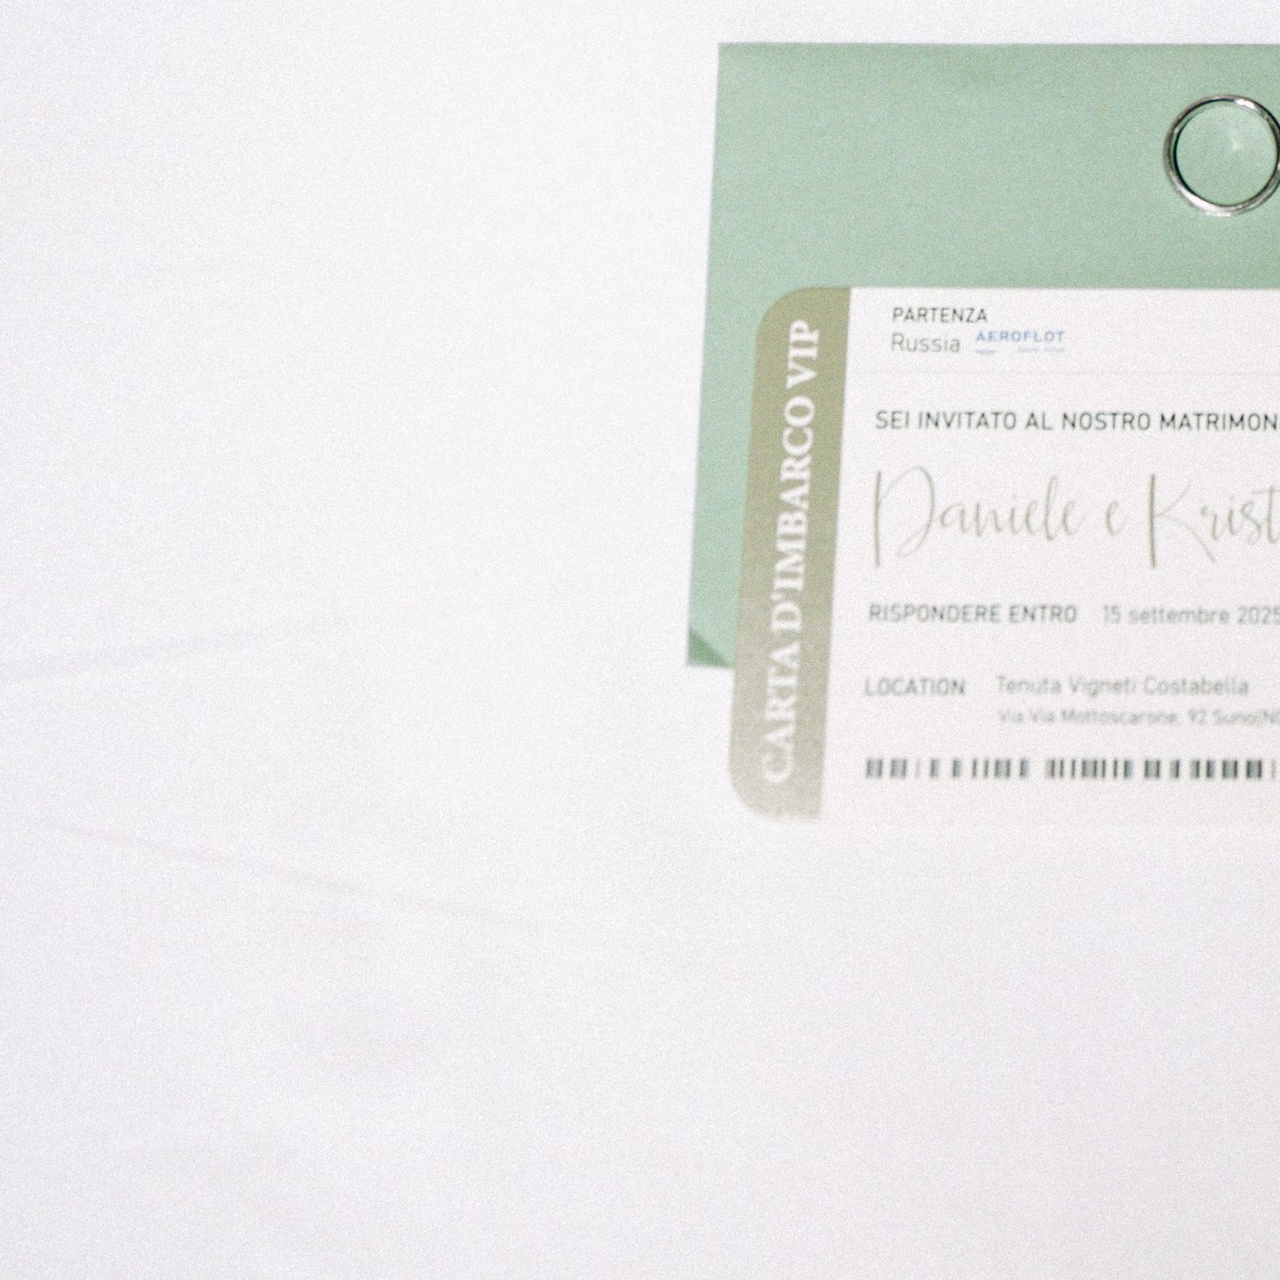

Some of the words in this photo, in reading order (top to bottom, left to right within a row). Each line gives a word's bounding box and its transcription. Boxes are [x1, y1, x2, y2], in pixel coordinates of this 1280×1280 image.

[891, 306, 988, 324] PARTENZA
[890, 332, 961, 354] Russia
[975, 330, 1066, 343] AEROFLOT
[785, 319, 820, 390] VIP
[874, 409, 911, 432] SEI
[917, 410, 1018, 432] INVITATO
[1024, 411, 1054, 432] AL
[1061, 410, 1152, 433] NOSTRO
[769, 395, 816, 632] D'IMBARCO
[873, 465, 1086, 569] Daniele
[1105, 498, 1129, 538] e
[868, 602, 1001, 625] RISPONDERE
[1008, 603, 1078, 625] ENTRO
[1102, 603, 1122, 624] 15
[1127, 603, 1232, 626] settembre
[865, 677, 967, 697] LOCATION
[996, 675, 1063, 695] Tenuta
[1068, 675, 1137, 699] Vigneti
[1142, 675, 1251, 696] Costabella
[760, 643, 802, 784] CARTA
